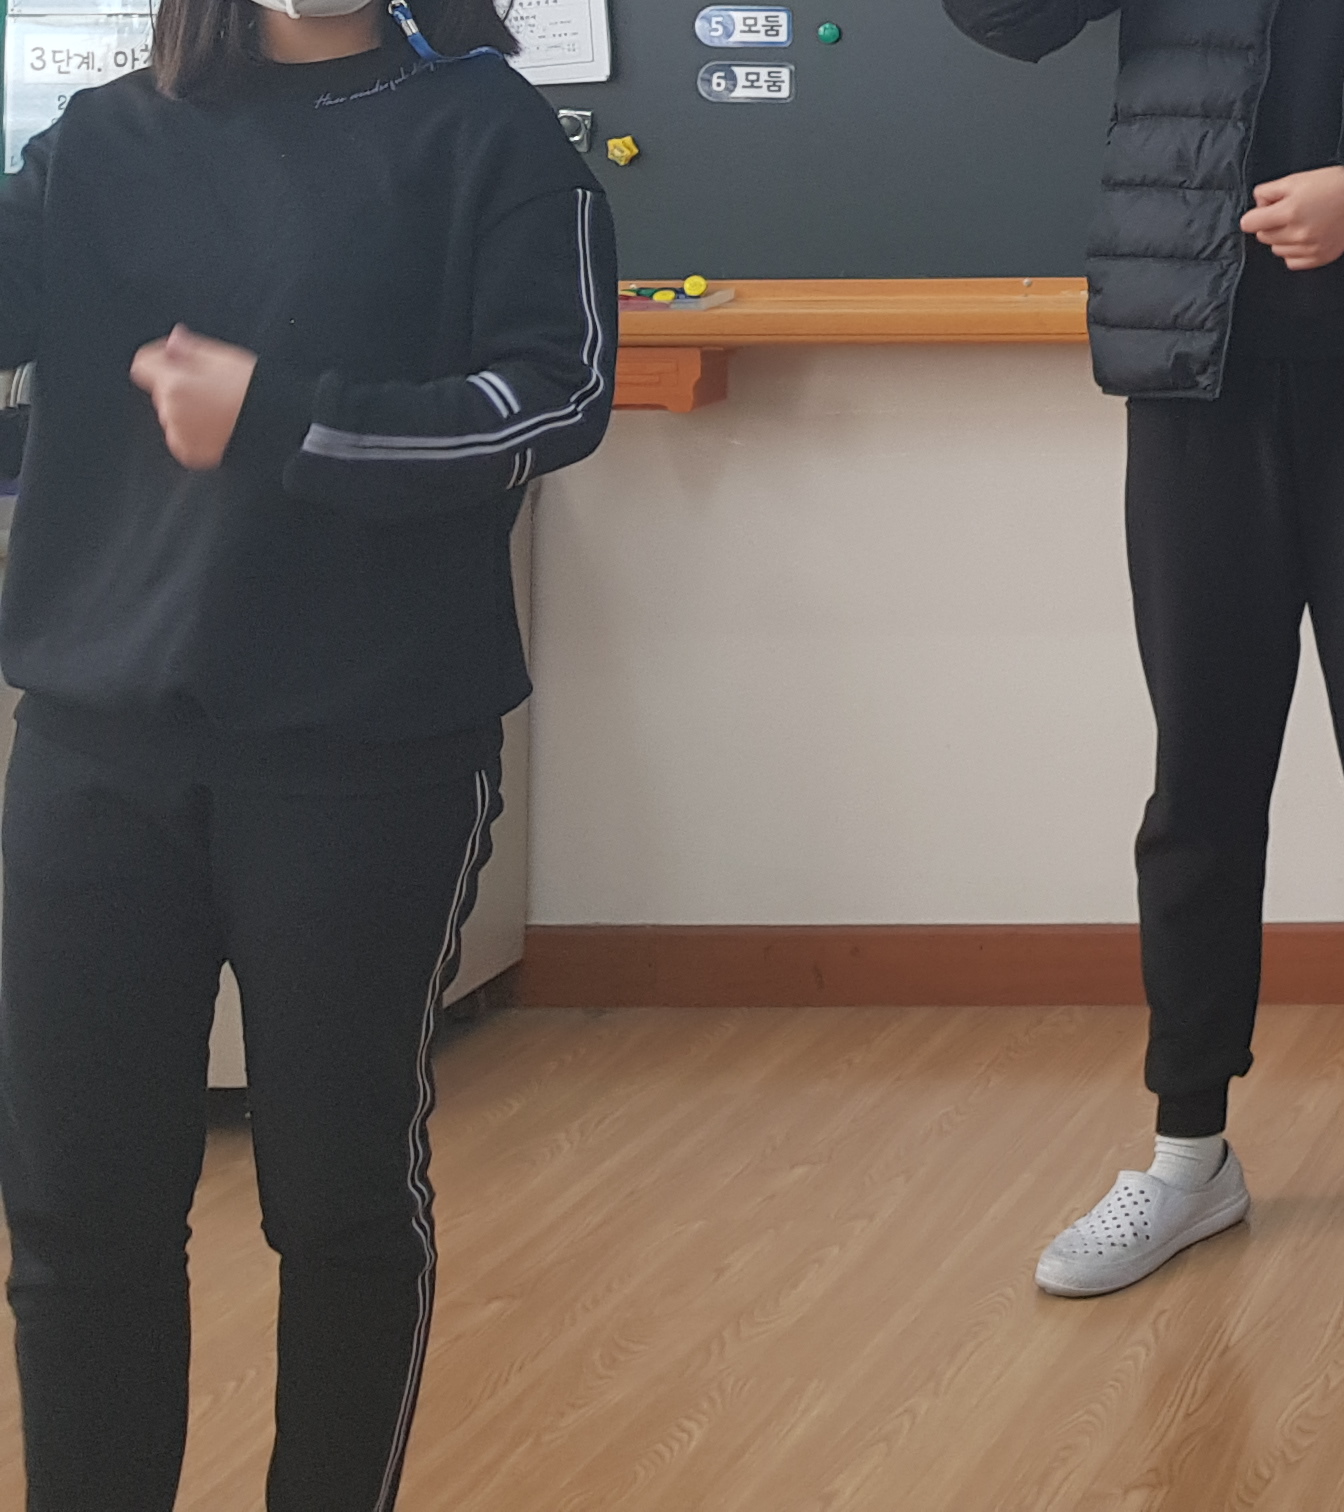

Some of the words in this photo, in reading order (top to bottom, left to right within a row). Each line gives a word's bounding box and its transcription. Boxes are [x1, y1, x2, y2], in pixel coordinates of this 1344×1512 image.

[709, 17, 724, 36] 5
[738, 14, 783, 38] 모둠
[30, 46, 102, 74] 3단계.
[712, 72, 726, 91] 6
[741, 70, 785, 93] 모둠
